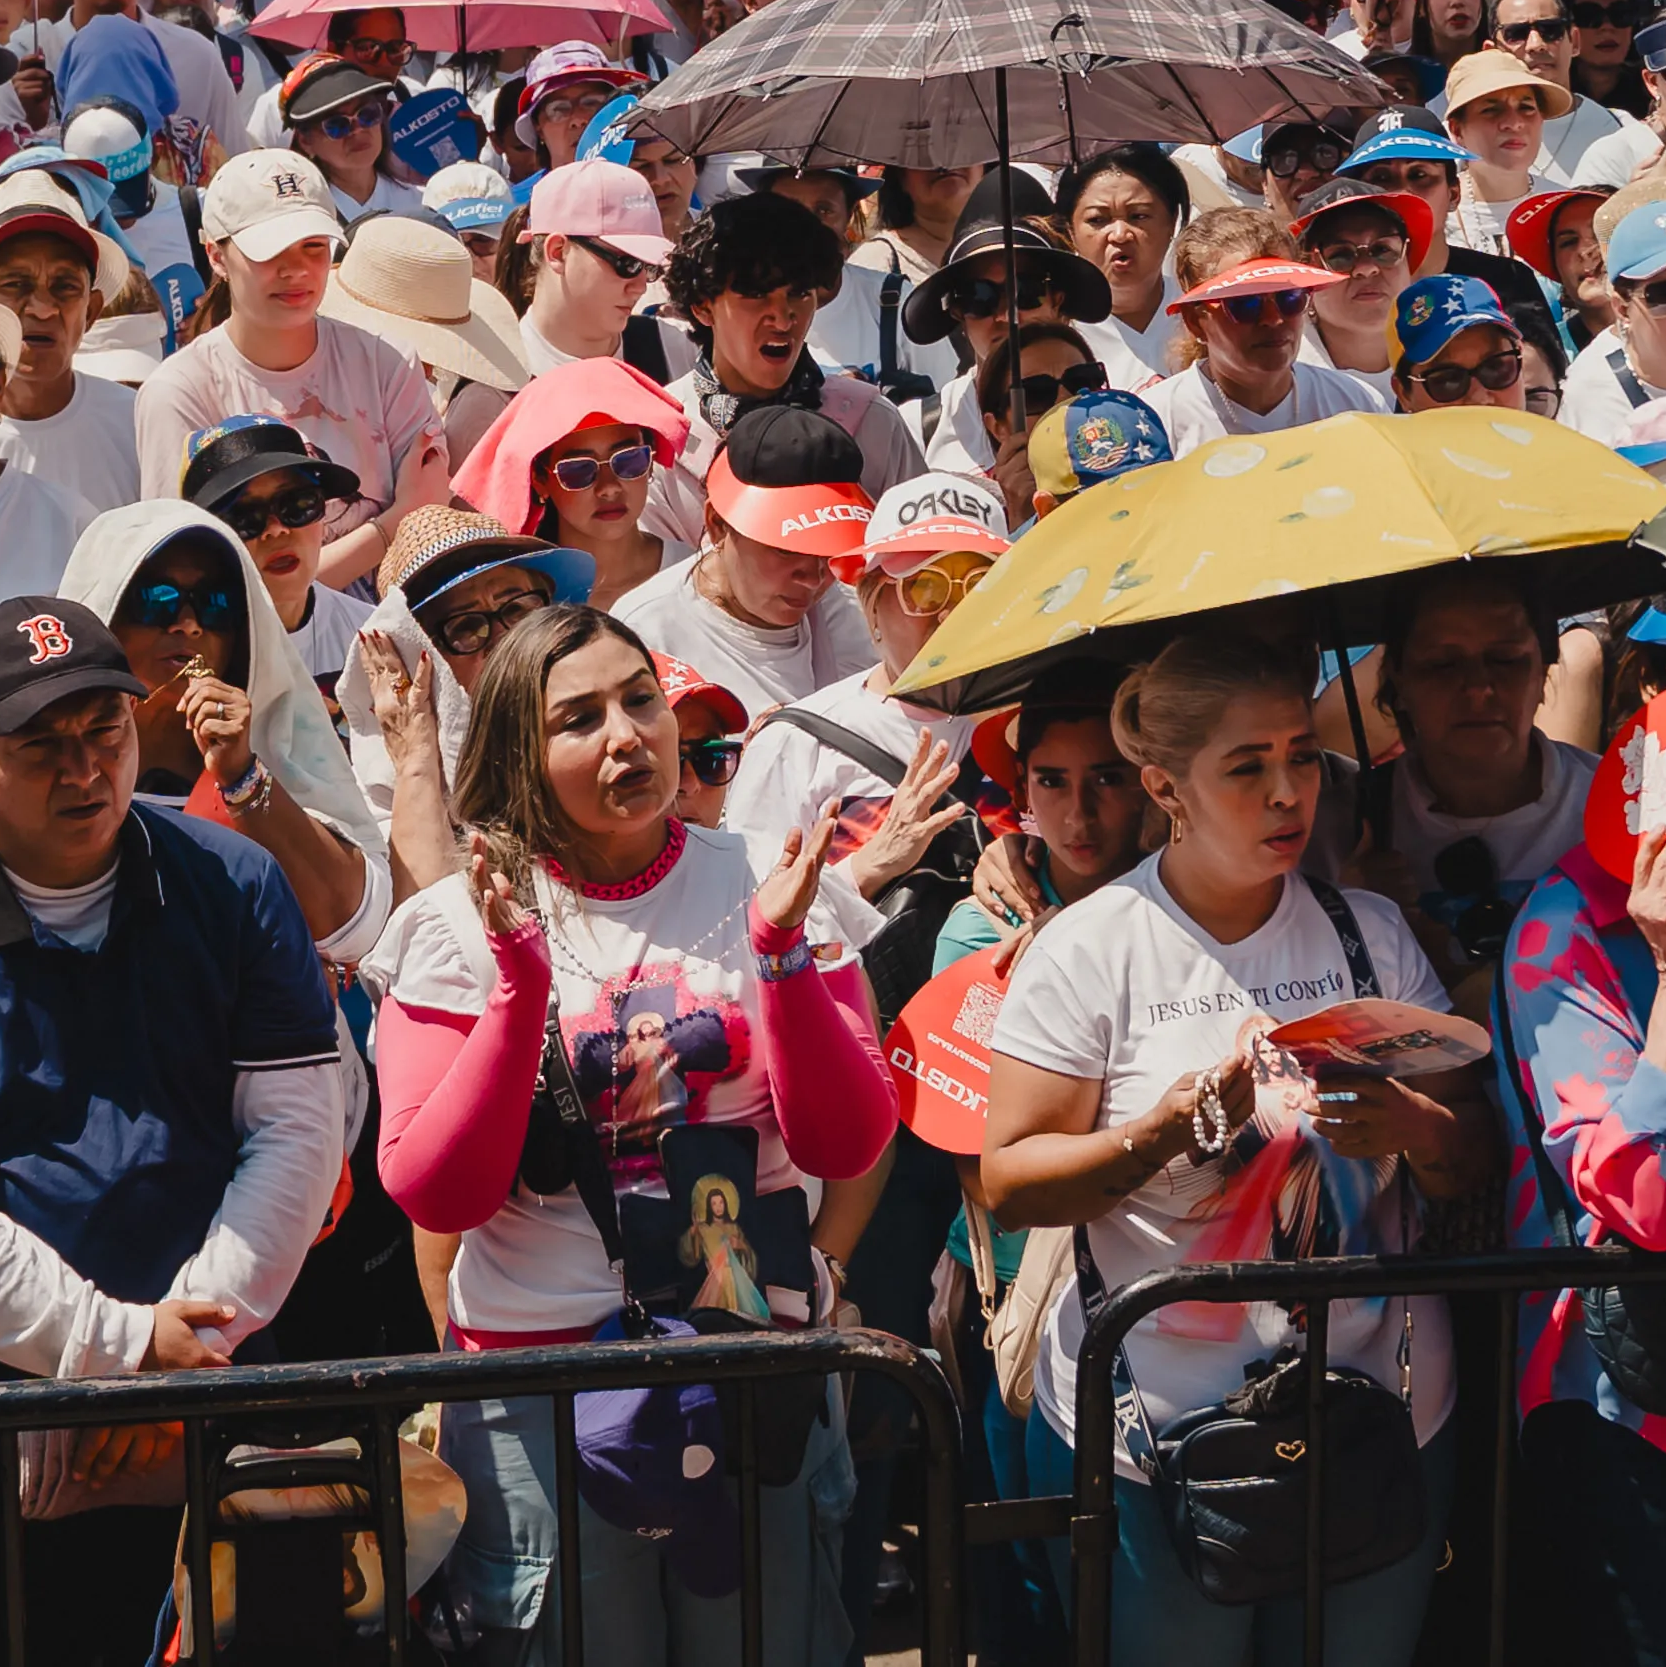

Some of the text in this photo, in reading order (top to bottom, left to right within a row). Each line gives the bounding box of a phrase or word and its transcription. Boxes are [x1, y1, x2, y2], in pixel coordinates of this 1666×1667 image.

[392, 94, 461, 143] ALKOSTO
[1351, 130, 1466, 164] ALKOSTO
[271, 173, 298, 198] H
[1204, 264, 1336, 294] ALKOSTO
[166, 279, 184, 333] ALKO
[781, 502, 875, 537] ALKOST
[897, 488, 991, 527] OAKLEY
[16, 614, 73, 665] B
[1147, 971, 1343, 1027] JESUS EN TI CONFÍO
[889, 1045, 990, 1120] LKOSTO
